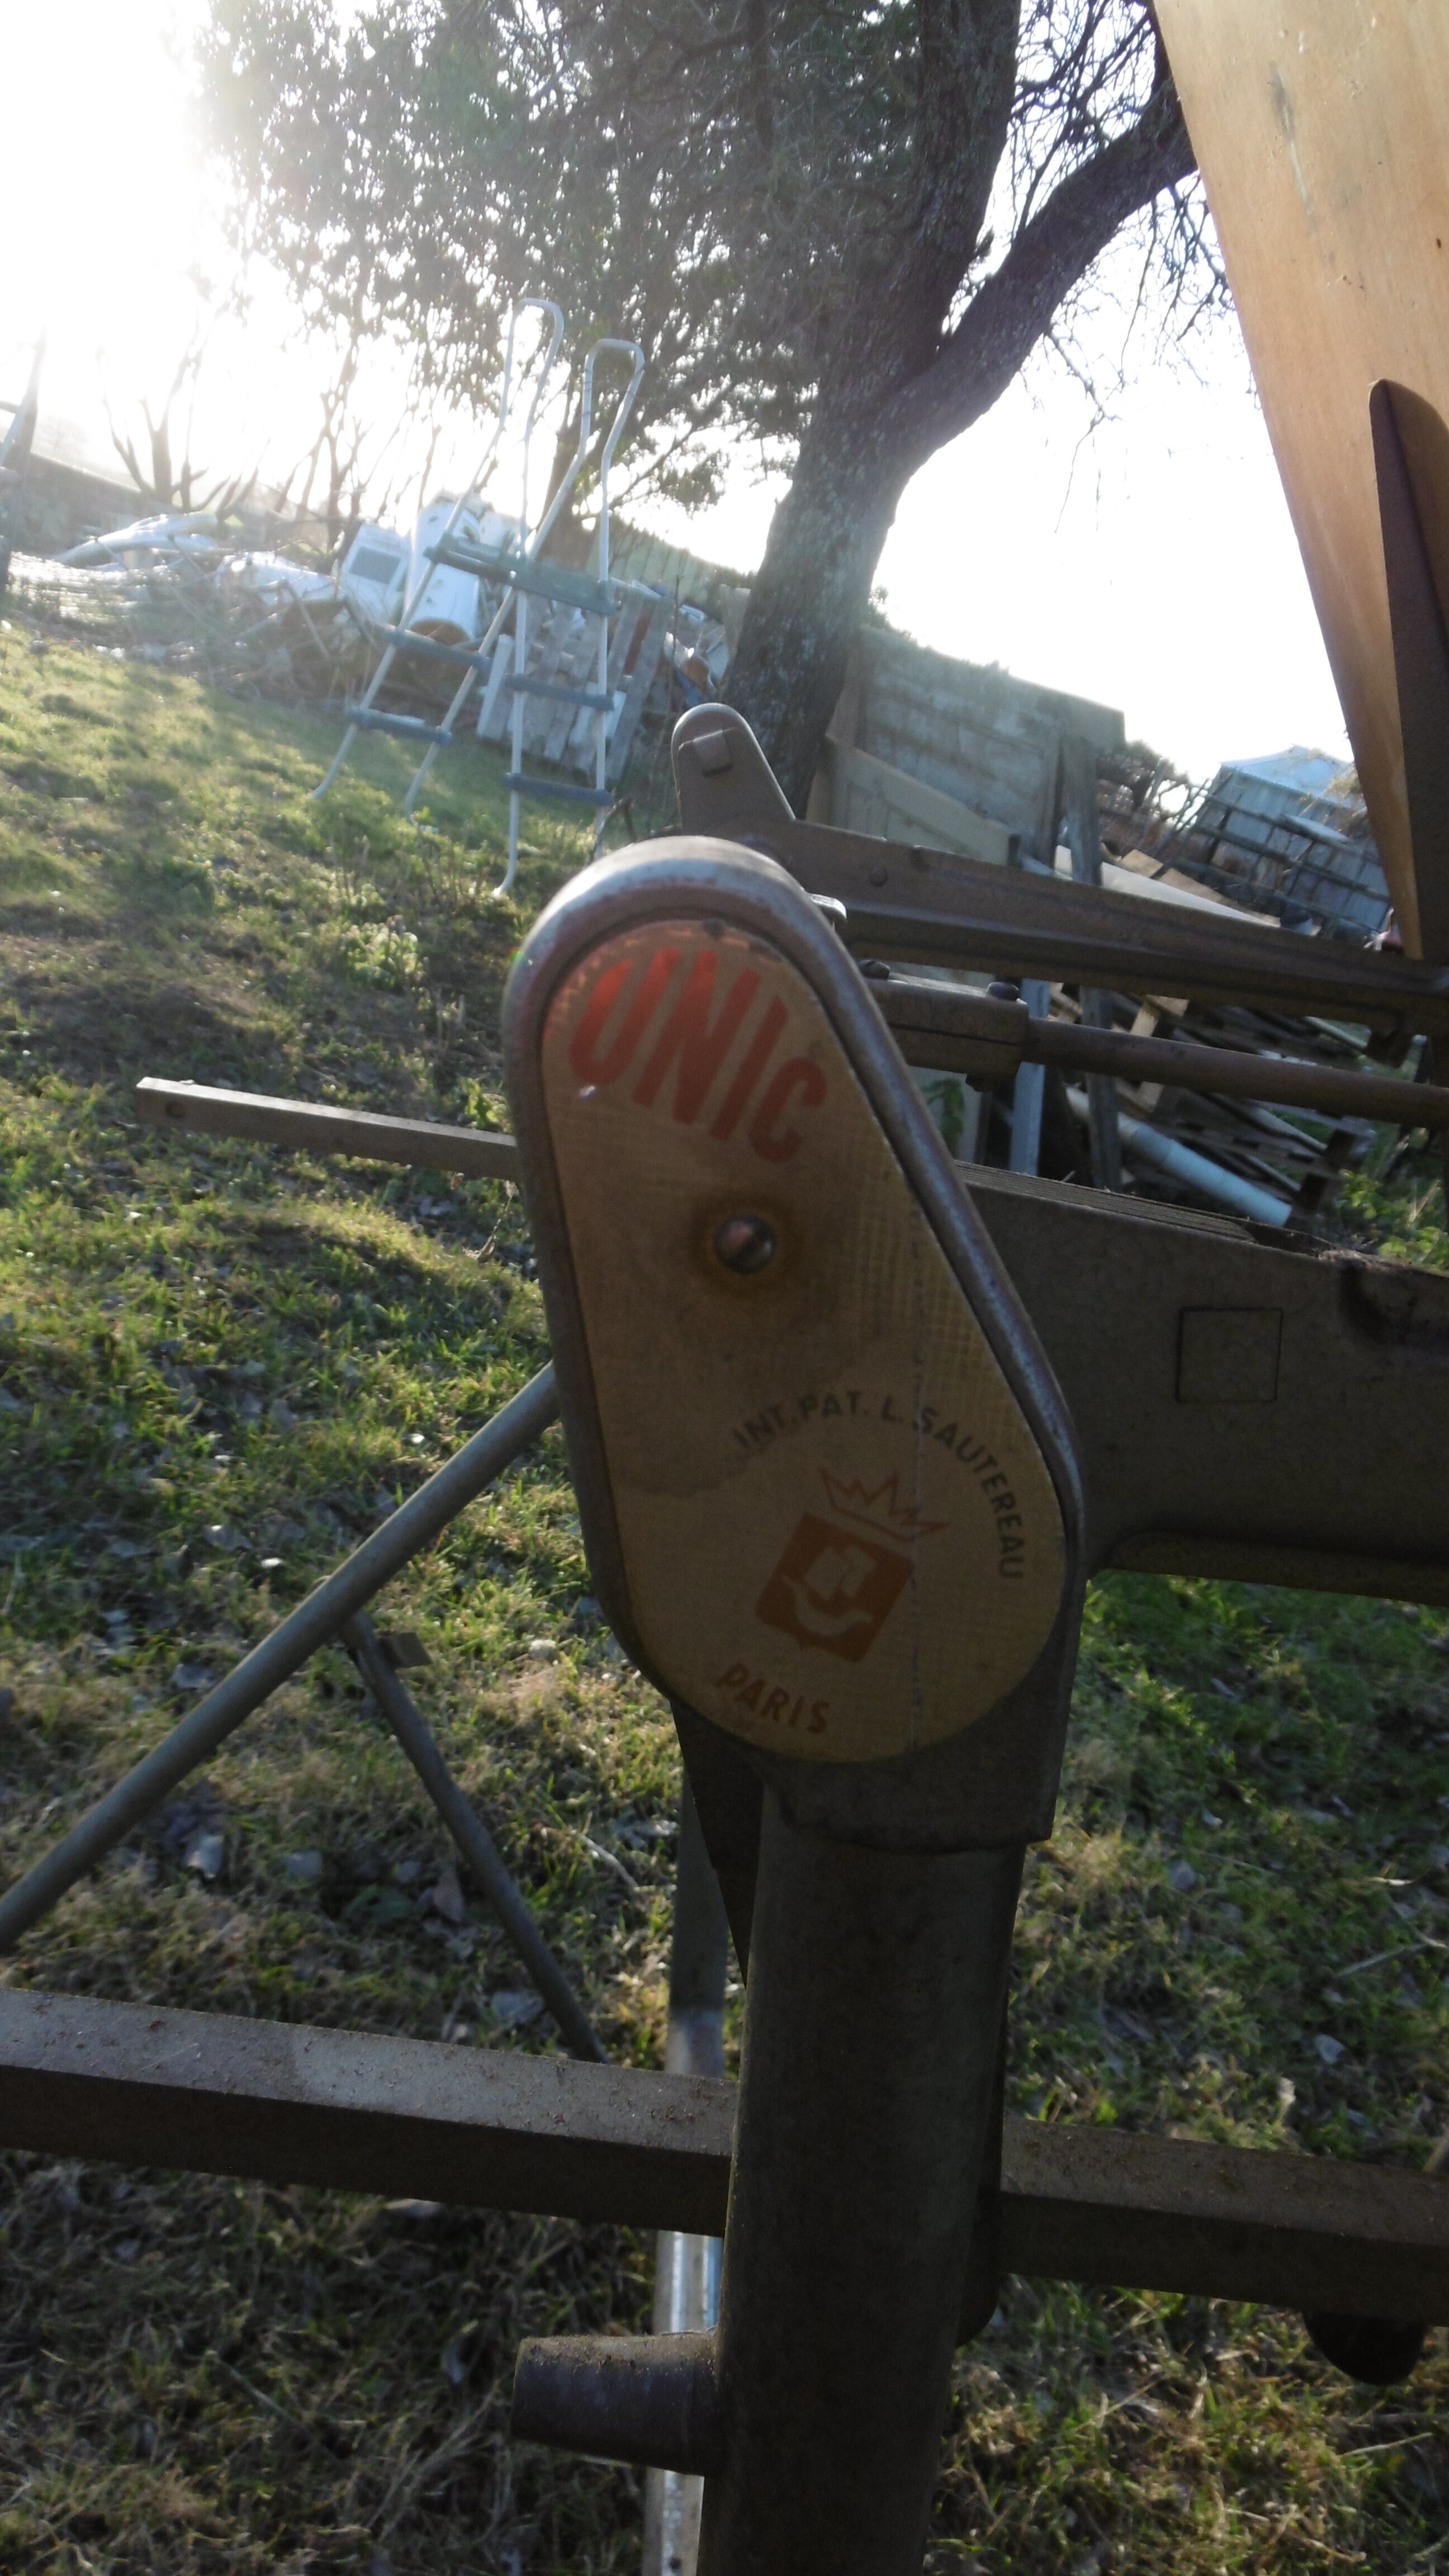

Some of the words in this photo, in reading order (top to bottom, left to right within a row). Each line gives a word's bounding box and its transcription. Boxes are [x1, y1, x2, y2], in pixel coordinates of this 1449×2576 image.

[568, 948, 827, 1163] UNIC
[912, 1405, 1025, 1579] SAUTEREAU
[714, 1662, 830, 1734] PARIS
